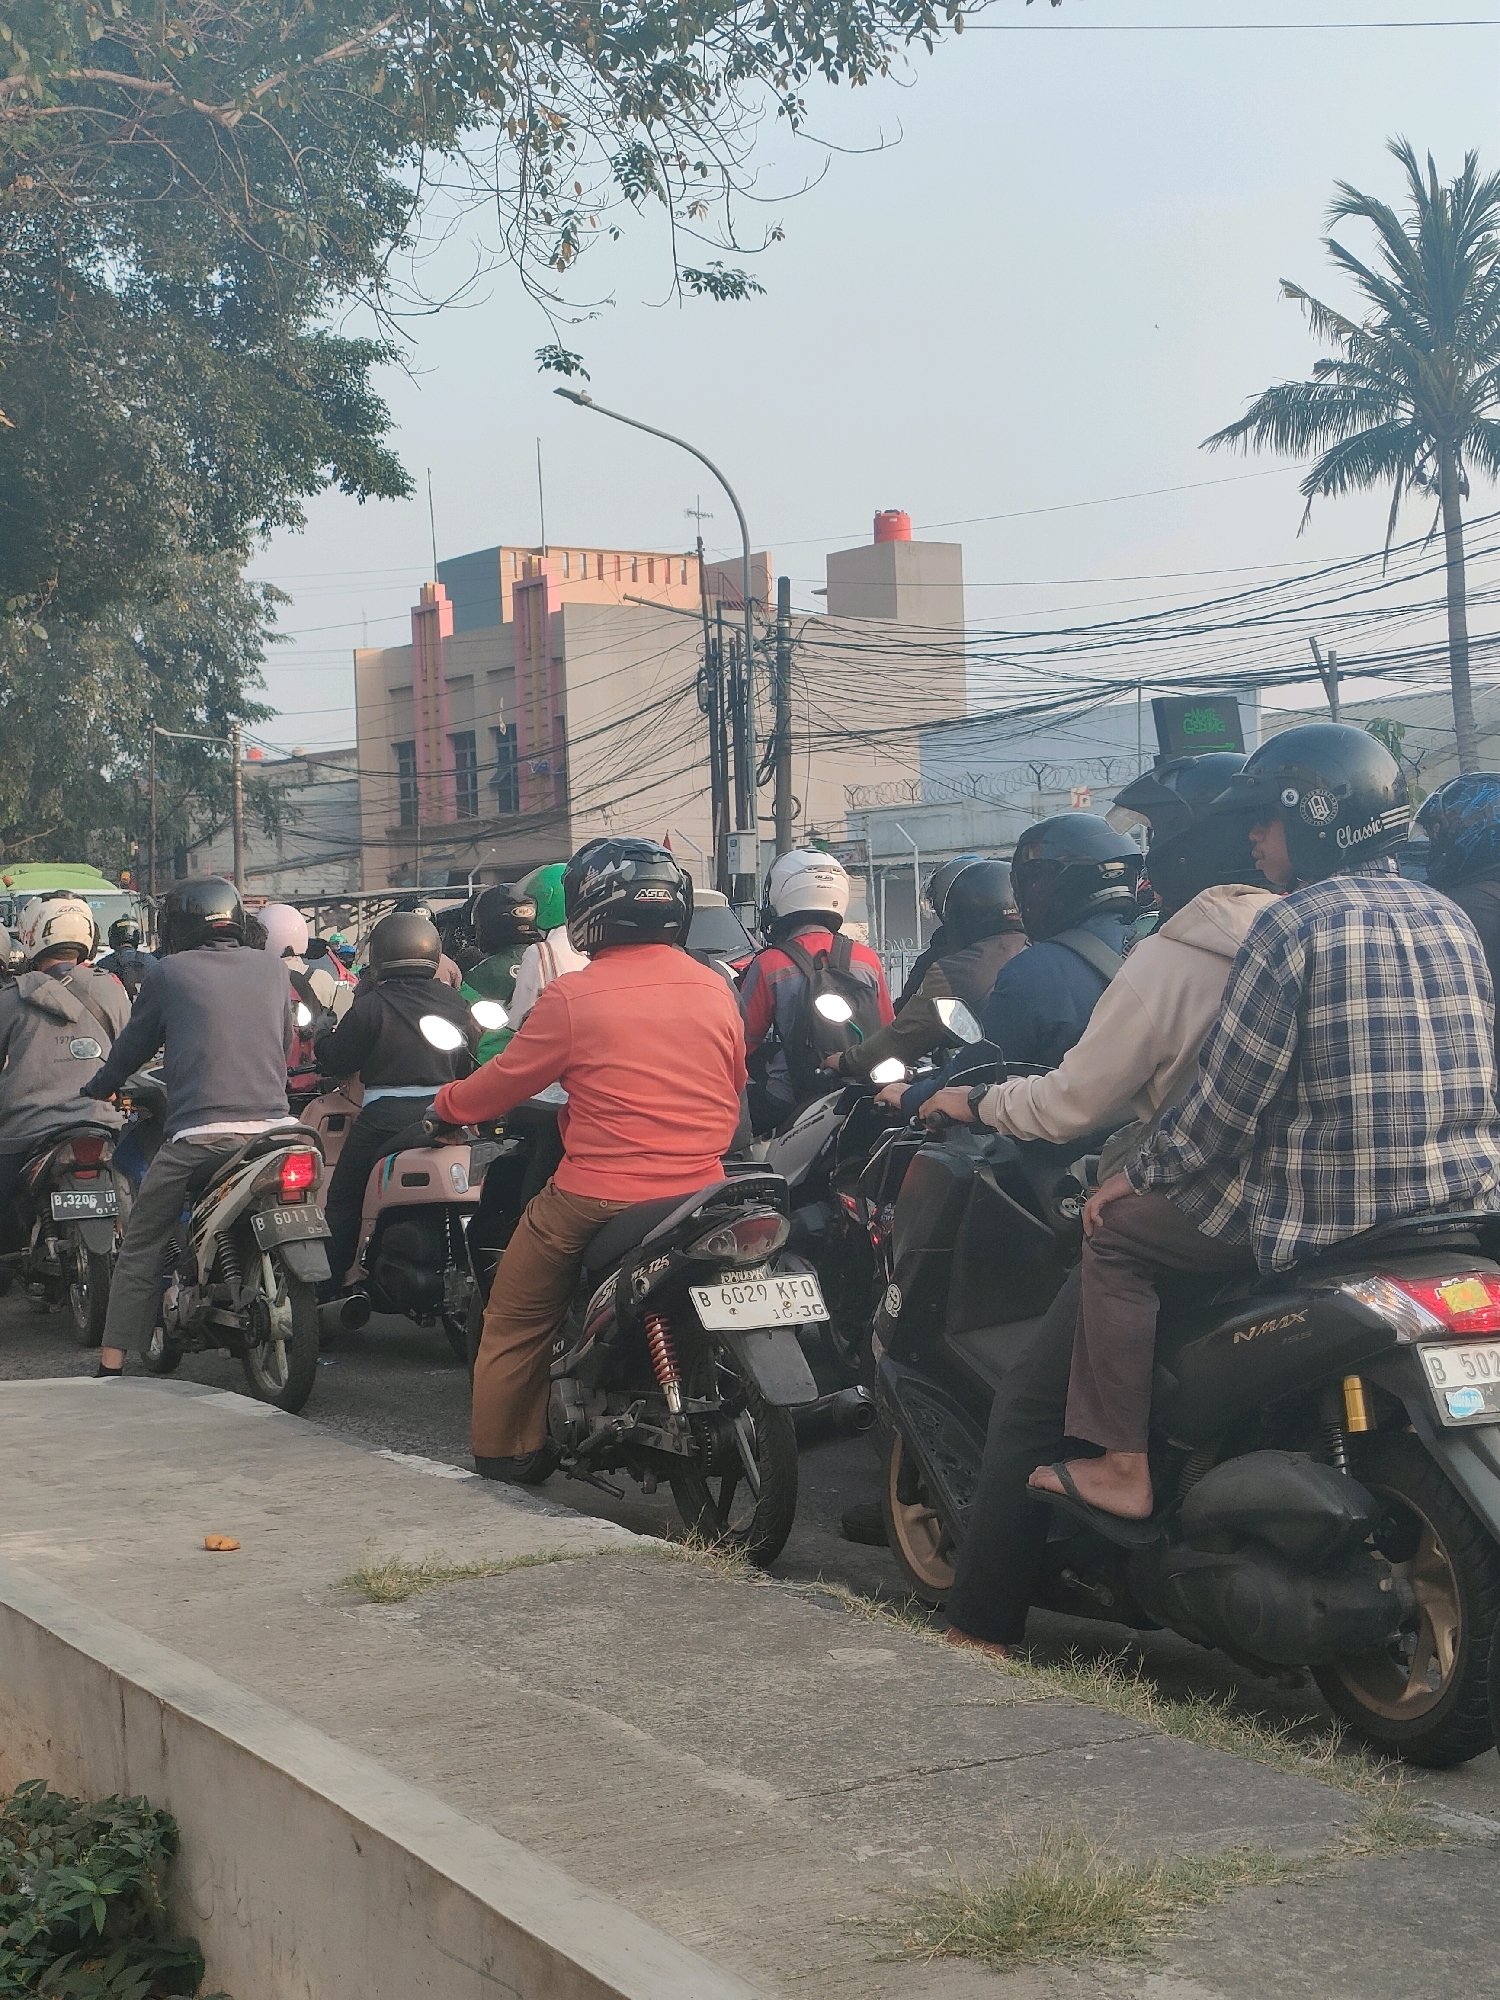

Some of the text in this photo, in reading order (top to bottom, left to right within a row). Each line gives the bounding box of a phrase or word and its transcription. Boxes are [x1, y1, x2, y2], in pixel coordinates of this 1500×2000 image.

[1336, 816, 1383, 849] Classic
[53, 1194, 62, 1206] B
[255, 1217, 265, 1231] B
[273, 1209, 309, 1225] 6011
[697, 1291, 712, 1308] B
[721, 1284, 768, 1306] 6029
[1233, 1308, 1309, 1344] NMAX
[1429, 1356, 1447, 1385] B
